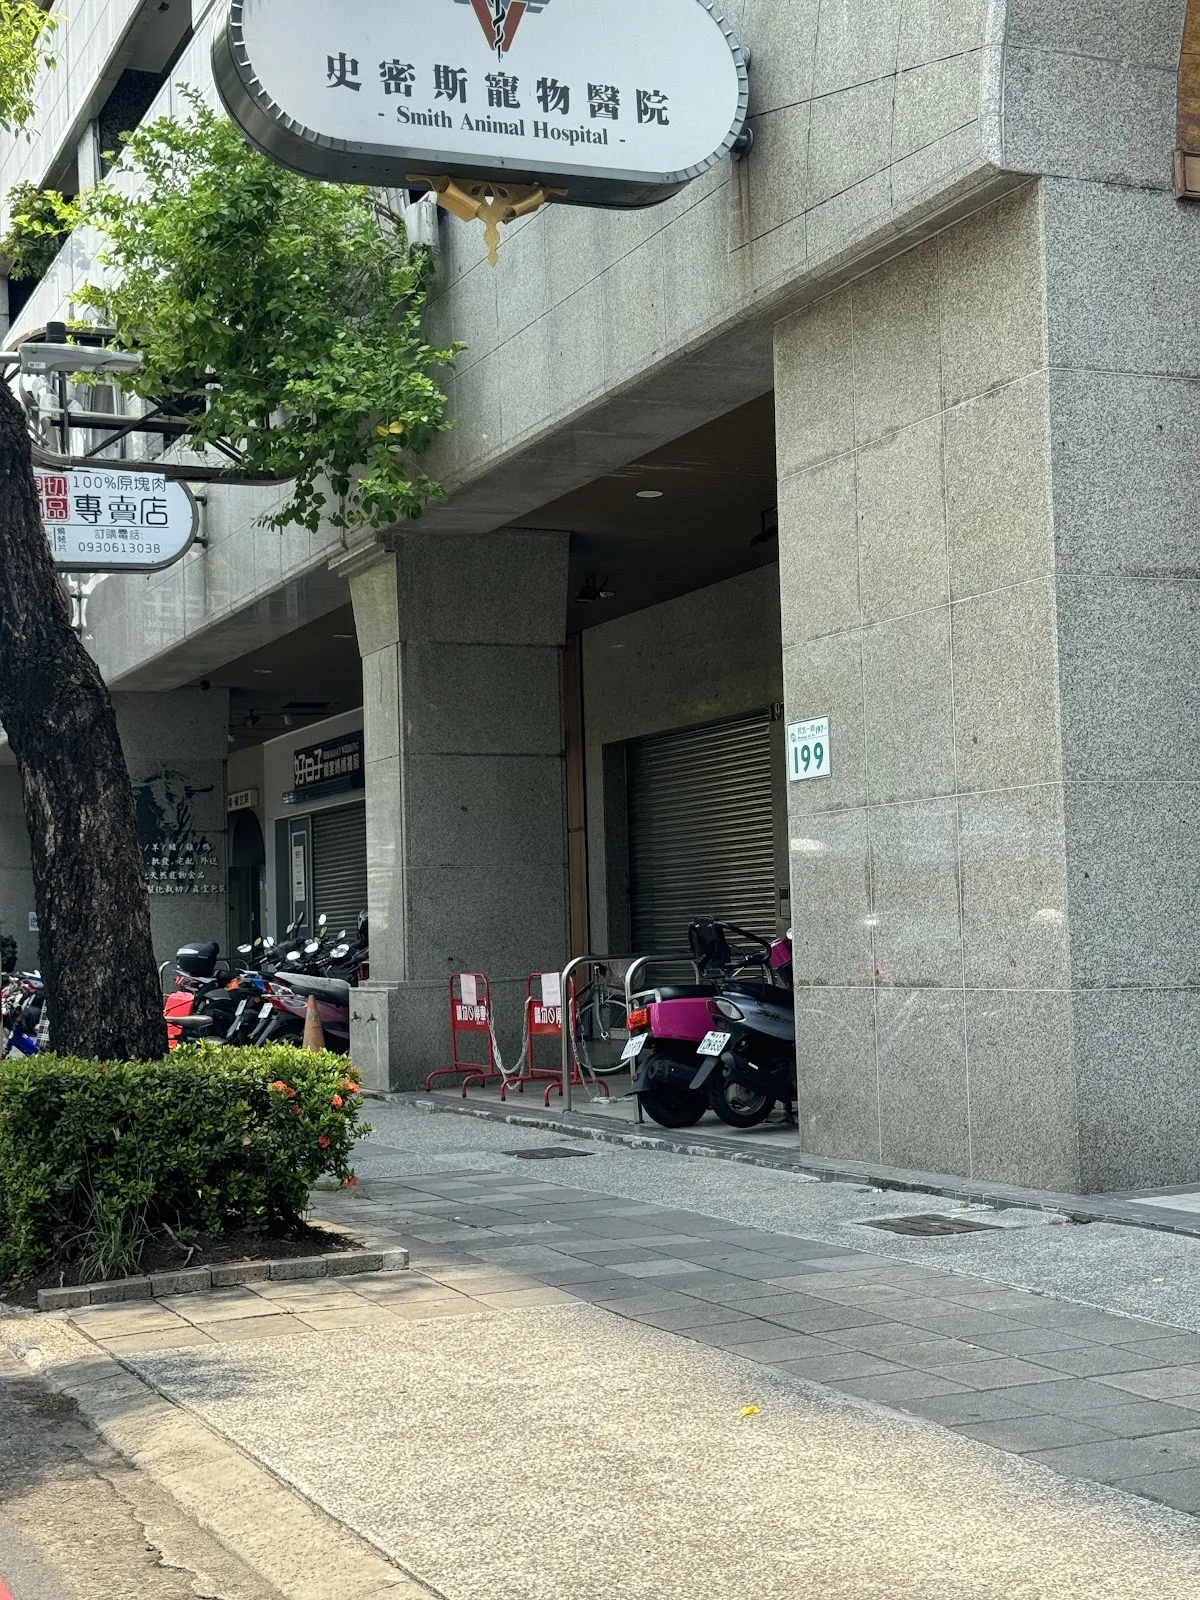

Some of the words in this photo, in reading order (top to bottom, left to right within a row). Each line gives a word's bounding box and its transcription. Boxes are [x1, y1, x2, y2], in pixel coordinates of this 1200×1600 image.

[326, 51, 671, 127] 史密斯寵物醫院
[396, 105, 453, 130] Smith
[459, 113, 525, 138] Animal
[533, 120, 609, 147] Hospital
[73, 494, 168, 525] 專賣店
[78, 542, 161, 554] 0930613038
[794, 742, 824, 774] 199
